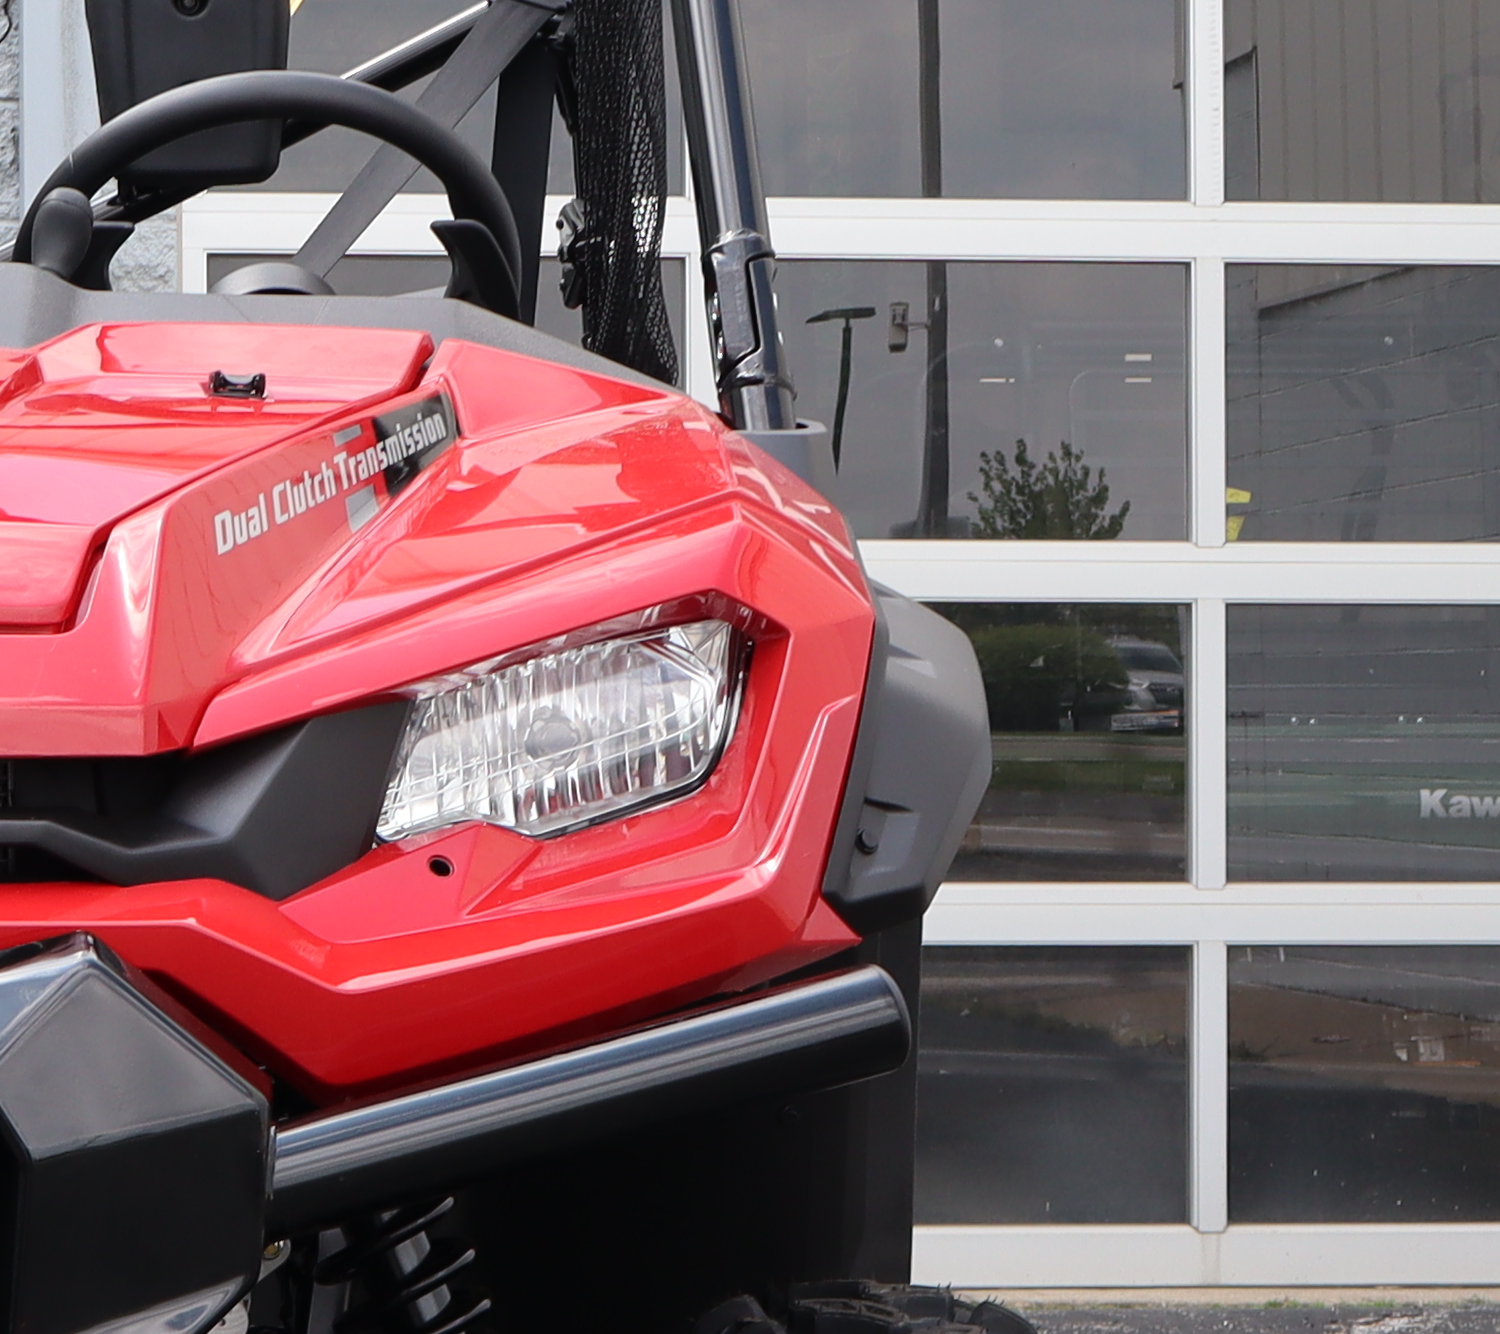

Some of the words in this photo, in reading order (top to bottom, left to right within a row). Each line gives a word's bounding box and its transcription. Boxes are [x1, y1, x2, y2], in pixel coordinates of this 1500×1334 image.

[214, 493, 269, 556] Dual
[272, 461, 337, 525] Clutch
[334, 413, 448, 491] Transmission
